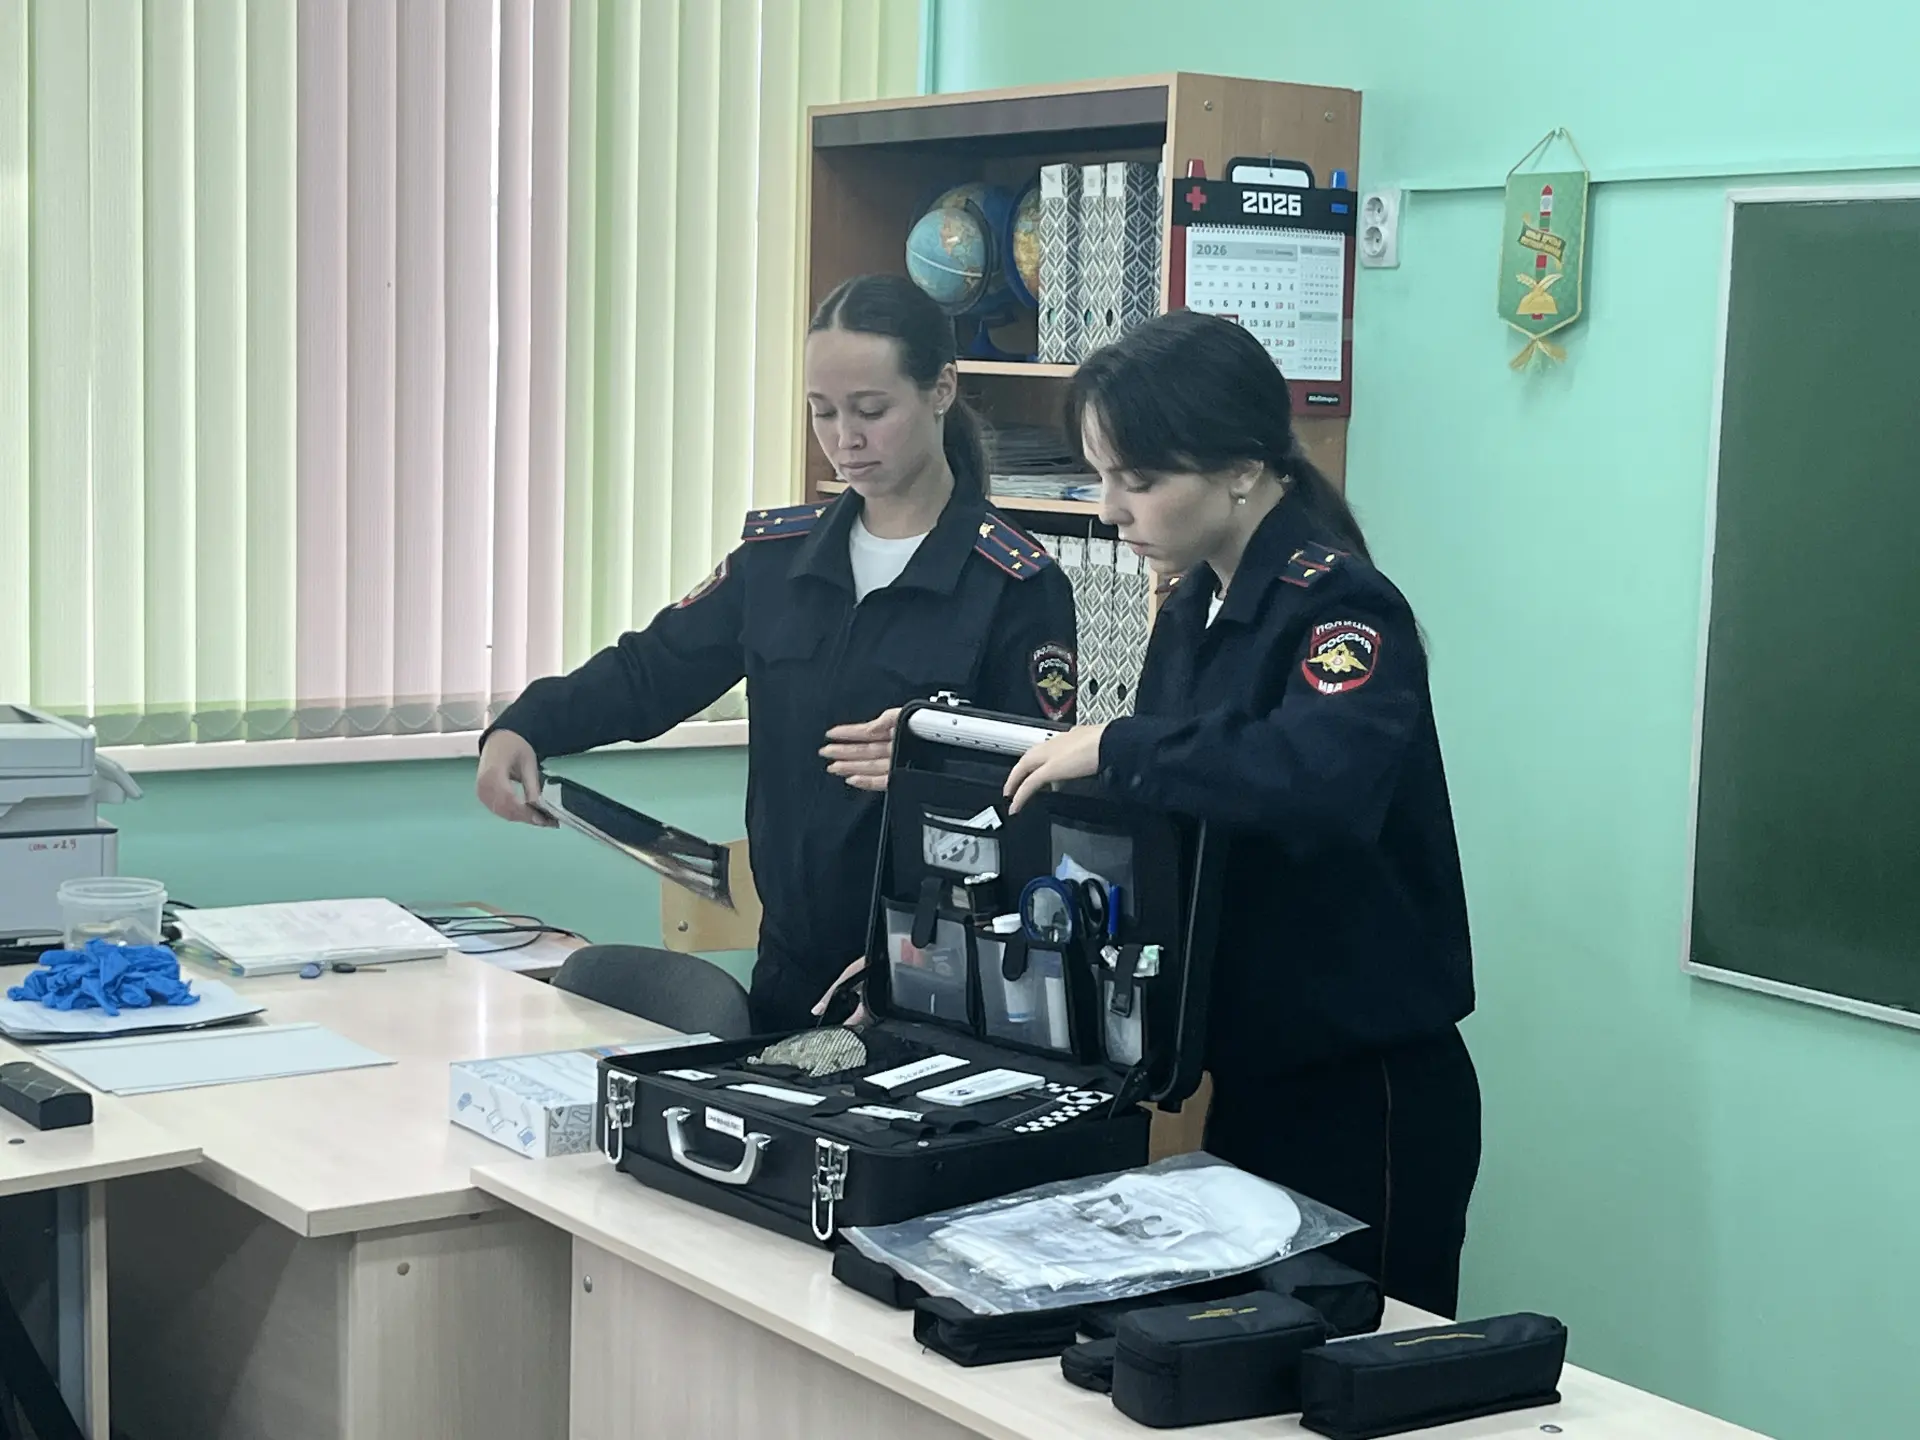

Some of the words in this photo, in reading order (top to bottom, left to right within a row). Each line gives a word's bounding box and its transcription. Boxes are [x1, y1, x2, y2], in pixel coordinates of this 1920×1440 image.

[1242, 191, 1301, 216] 2026
[1196, 244, 1227, 256] 2026
[1264, 282, 1269, 290] 2
[1209, 299, 1214, 307] 5
[1223, 299, 1228, 307] 6
[1238, 299, 1243, 307] 7
[1251, 300, 1256, 309] 8
[1264, 300, 1269, 308] 9
[1275, 301, 1284, 310] 10
[1318, 632, 1372, 654] РОССИЯ
